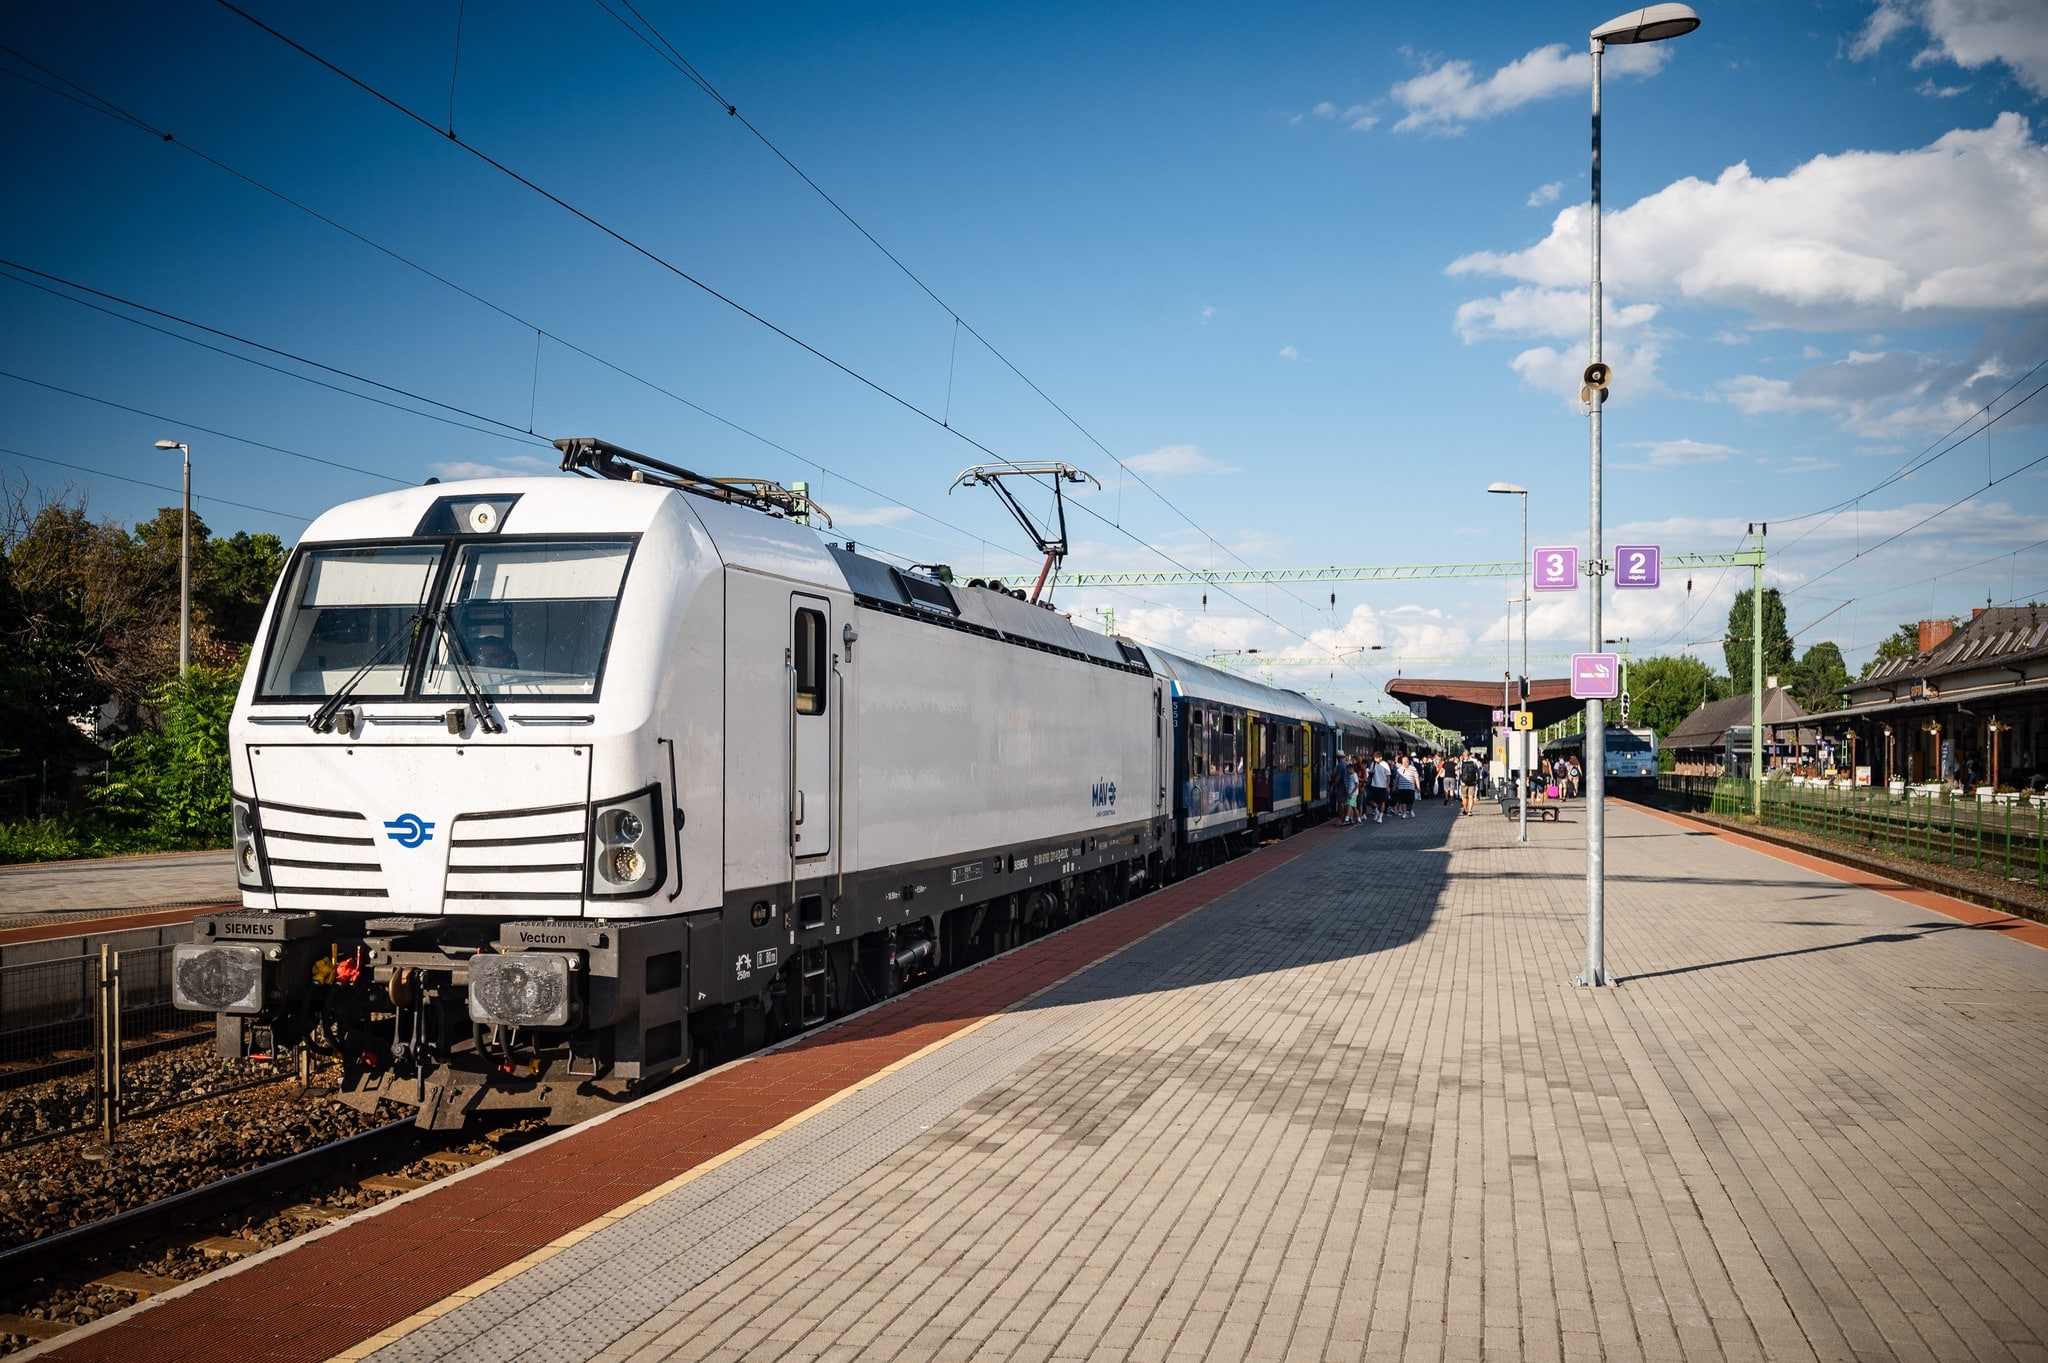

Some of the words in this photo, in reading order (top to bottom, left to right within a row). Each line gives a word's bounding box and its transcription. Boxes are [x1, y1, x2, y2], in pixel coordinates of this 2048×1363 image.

[1546, 553, 1564, 577] 3
[1629, 552, 1646, 574] 2
[1520, 716, 1528, 726] 8
[1091, 776, 1108, 807] MÁV
[225, 923, 274, 935] SIEMENS
[519, 931, 566, 944] Vectron
